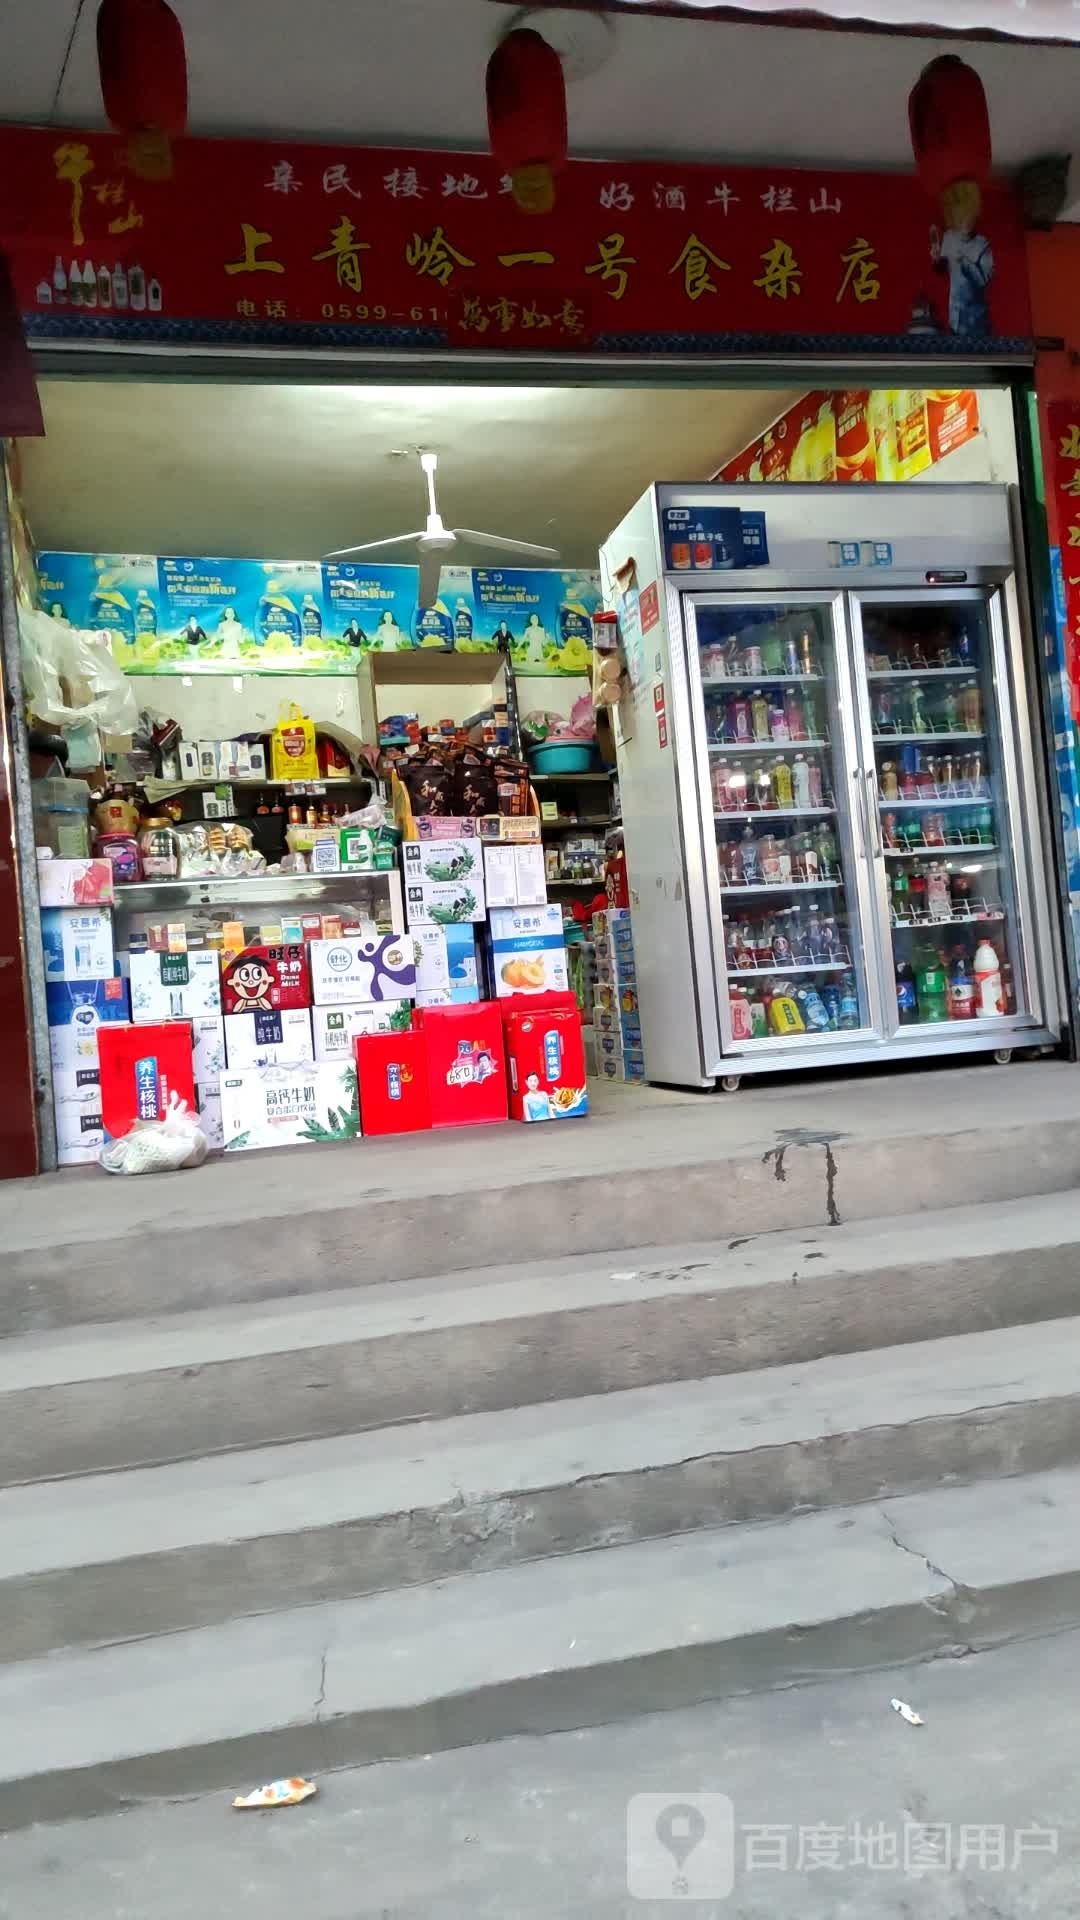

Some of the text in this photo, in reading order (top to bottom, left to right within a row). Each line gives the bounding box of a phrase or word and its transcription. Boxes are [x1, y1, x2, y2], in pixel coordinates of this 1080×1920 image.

[599, 181, 843, 216] 好酒牛栏山
[223, 215, 882, 305] 上青岭一号食杂店
[320, 302, 449, 323] 0599-61
[69, 916, 102, 929] 安慕希
[268, 945, 301, 961] 旺仔
[276, 960, 303, 973] 牛奶
[280, 980, 300, 988] MILK
[138, 1060, 157, 1119] 养生核桃
[265, 1086, 317, 1106] 高钙牛奶
